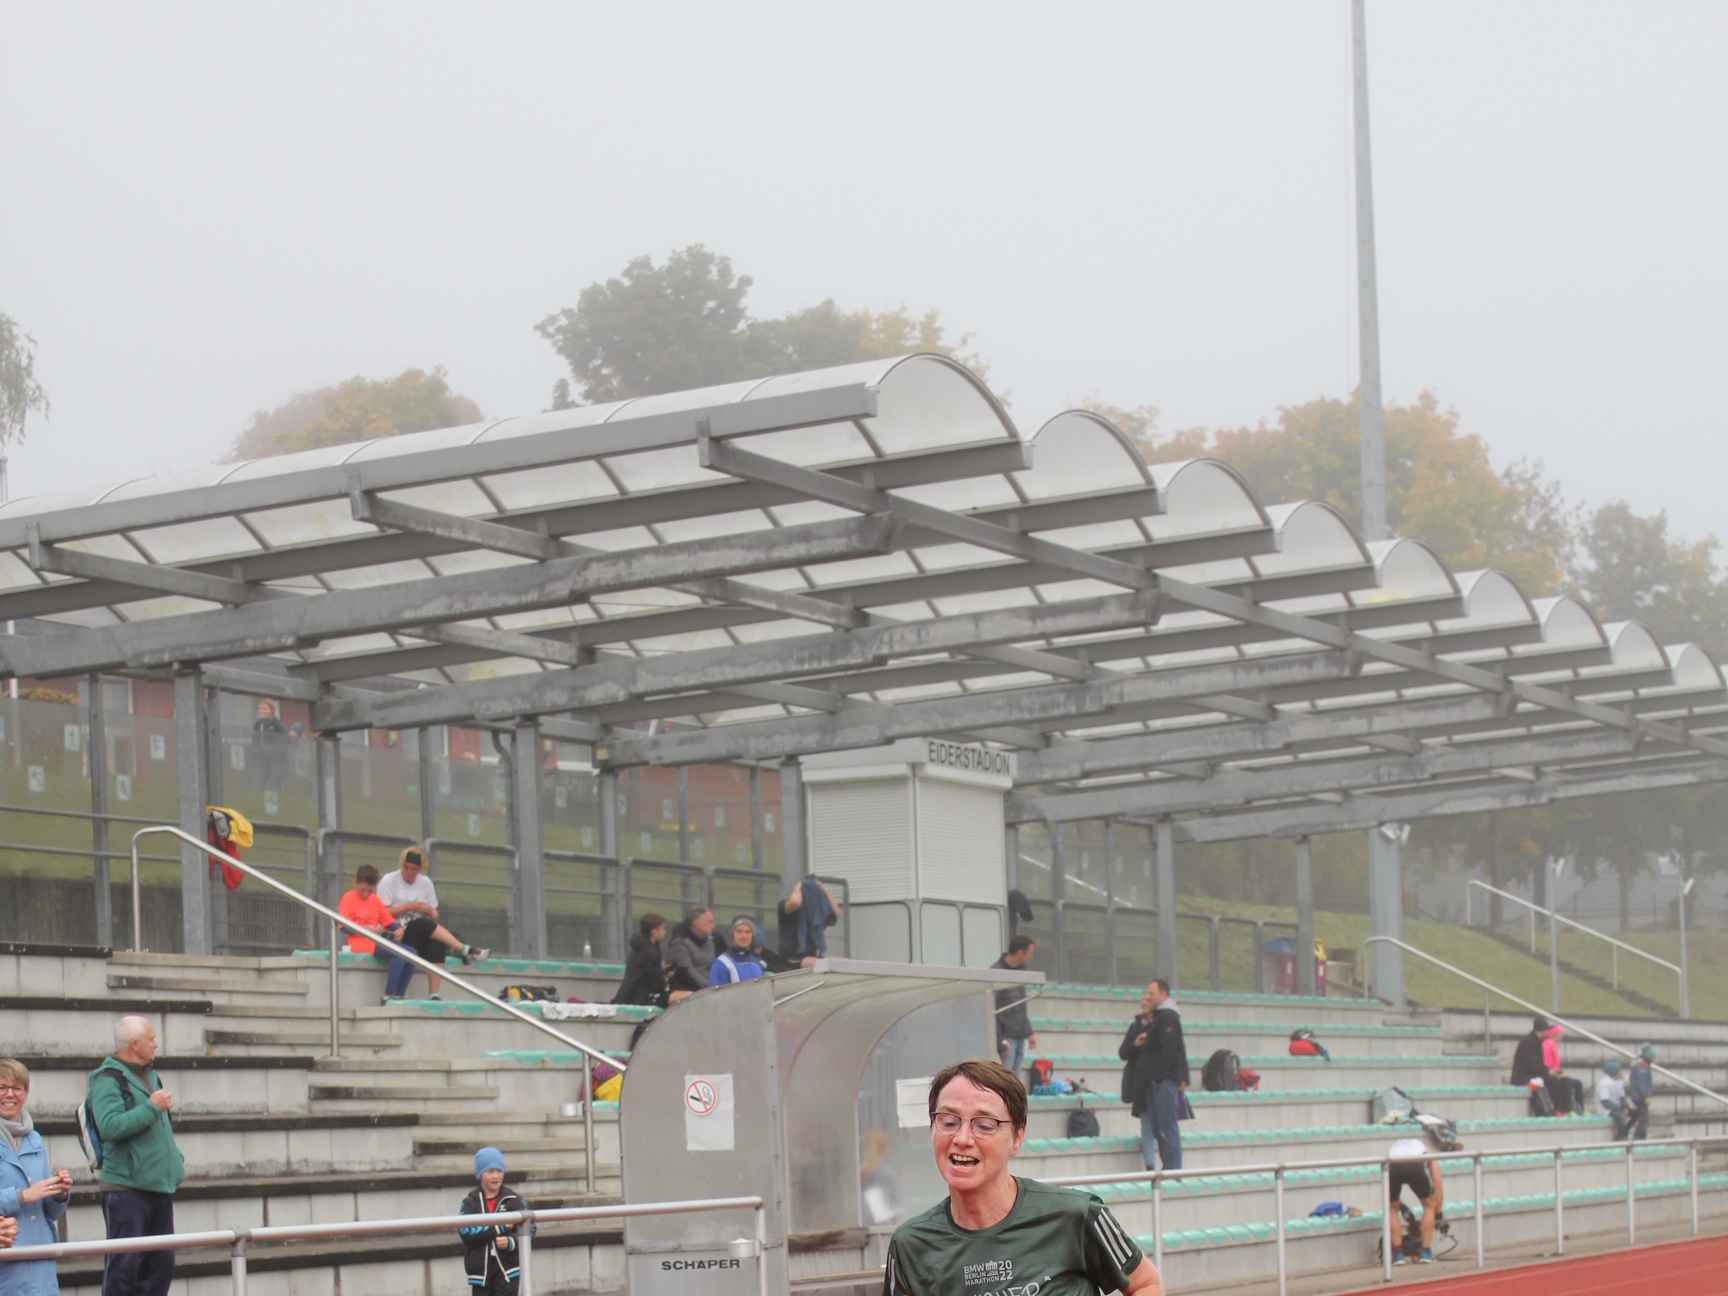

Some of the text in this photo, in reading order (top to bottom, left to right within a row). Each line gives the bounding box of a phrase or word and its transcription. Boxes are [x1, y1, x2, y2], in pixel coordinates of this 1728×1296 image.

[929, 741, 1010, 776] EIDERSTADION
[964, 1263, 984, 1274] BMW
[998, 1259, 1013, 1270] 20
[999, 1270, 1014, 1281] 22
